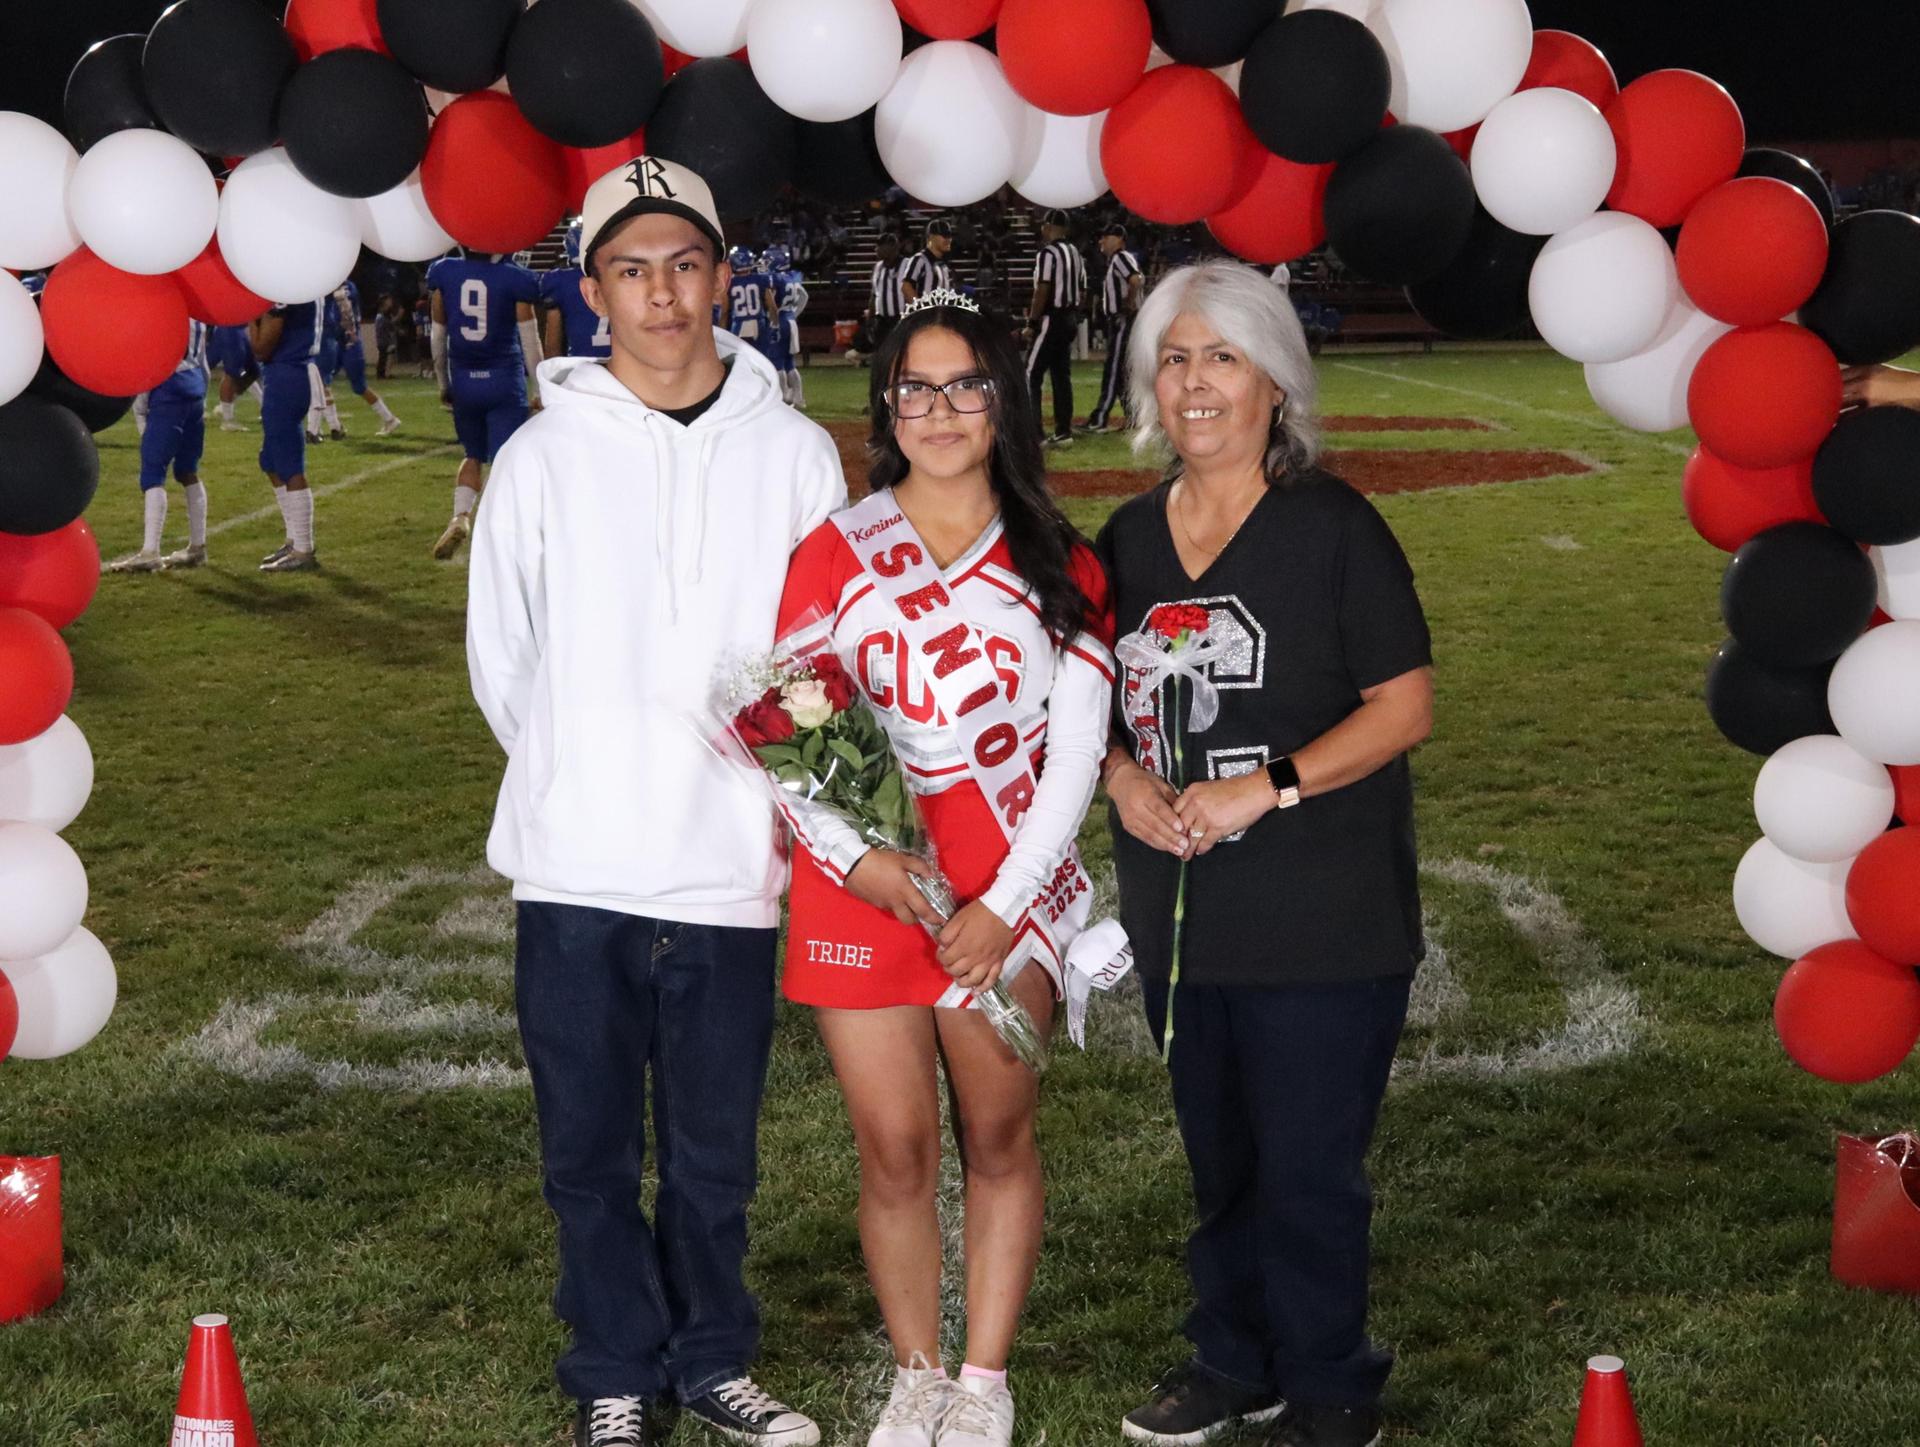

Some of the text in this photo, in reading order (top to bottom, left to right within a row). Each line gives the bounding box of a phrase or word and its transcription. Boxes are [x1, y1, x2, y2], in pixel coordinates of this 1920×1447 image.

[624, 157, 677, 198] R
[460, 279, 488, 341] 9
[731, 283, 761, 317] 20
[846, 513, 905, 543] Karina
[855, 627, 1024, 728] CUS
[871, 542, 1036, 829] SENIOR
[1047, 876, 1088, 923] 2024
[806, 940, 873, 969] TRIBE
